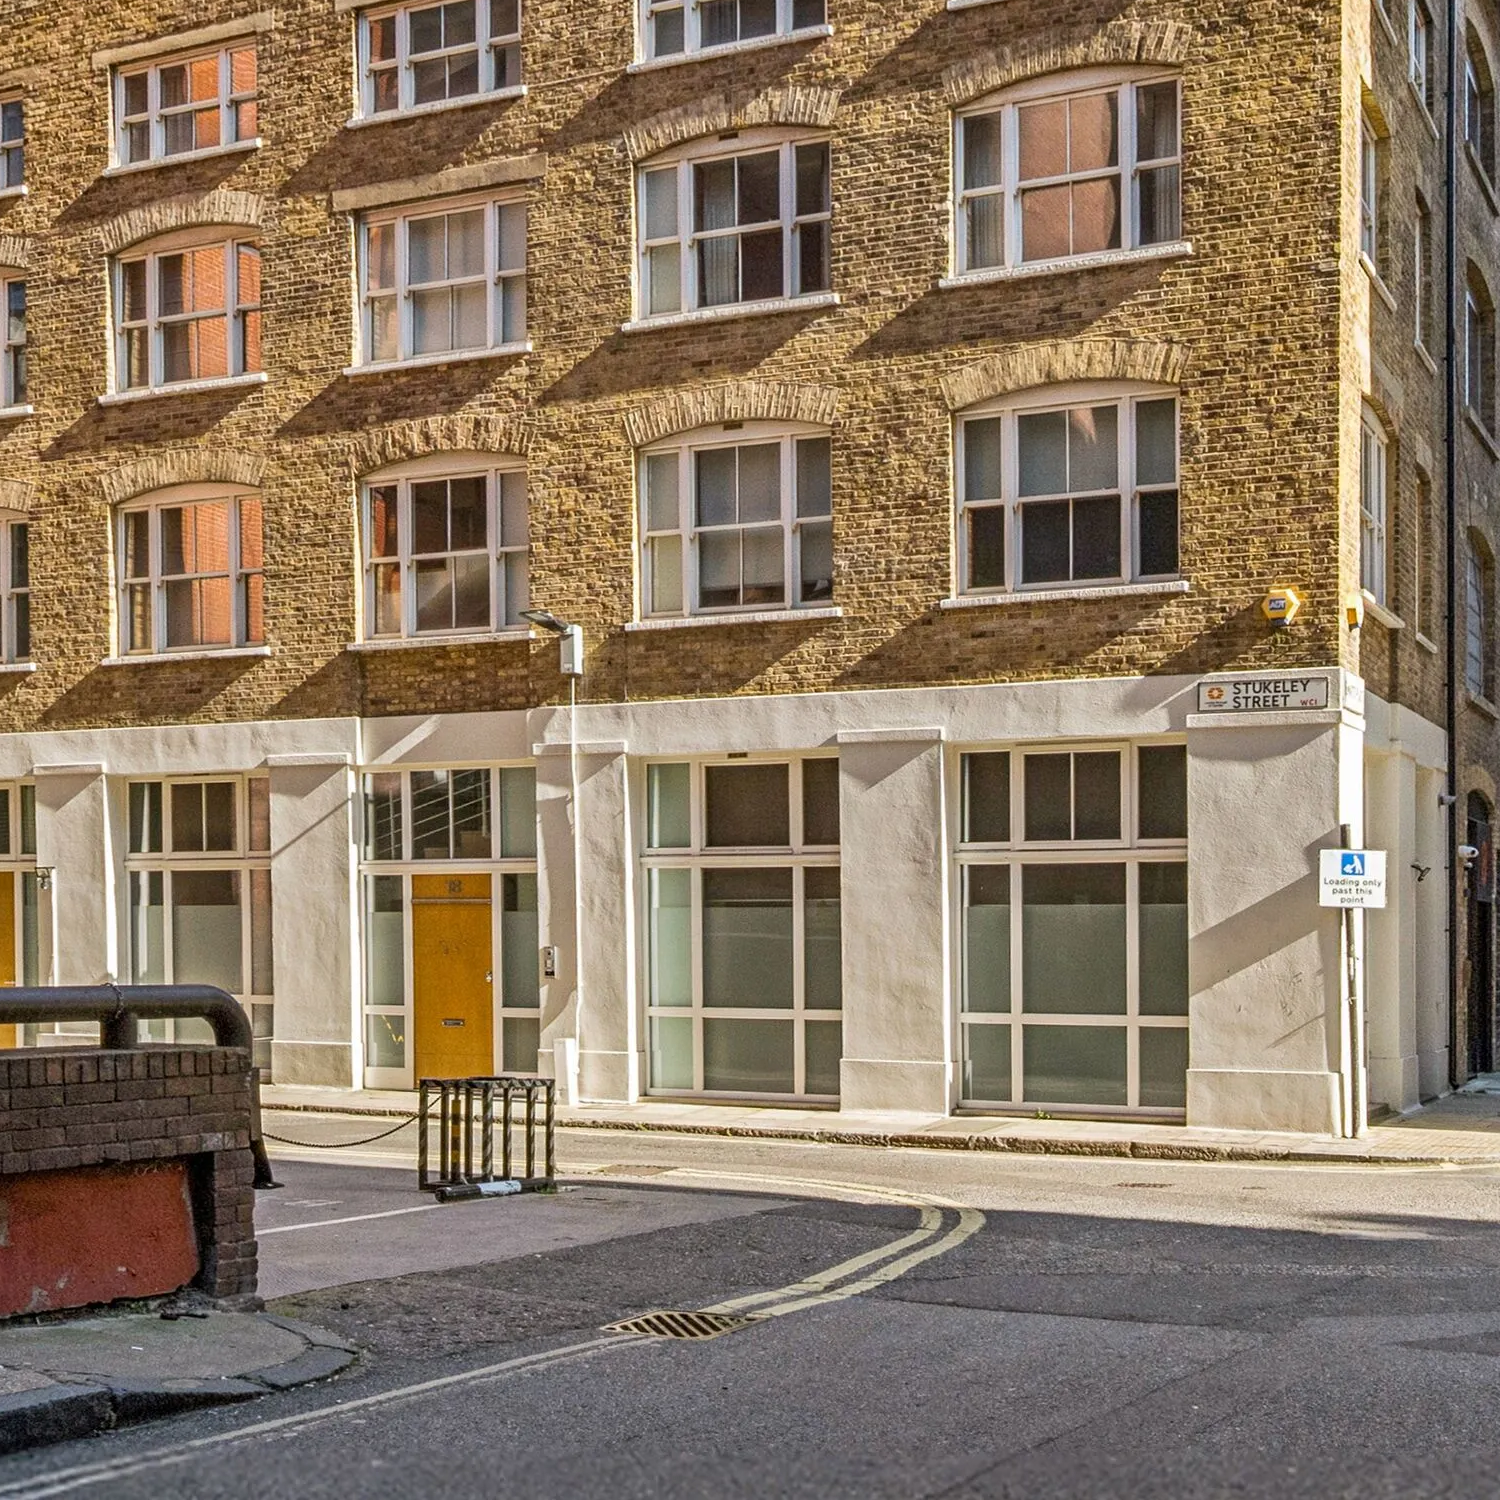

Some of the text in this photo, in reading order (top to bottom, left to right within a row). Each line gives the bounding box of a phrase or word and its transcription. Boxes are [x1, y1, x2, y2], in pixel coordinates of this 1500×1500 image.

[1233, 679, 1310, 695] STUKELEY
[1233, 694, 1290, 709] STREET
[1323, 877, 1382, 887] Loading only
